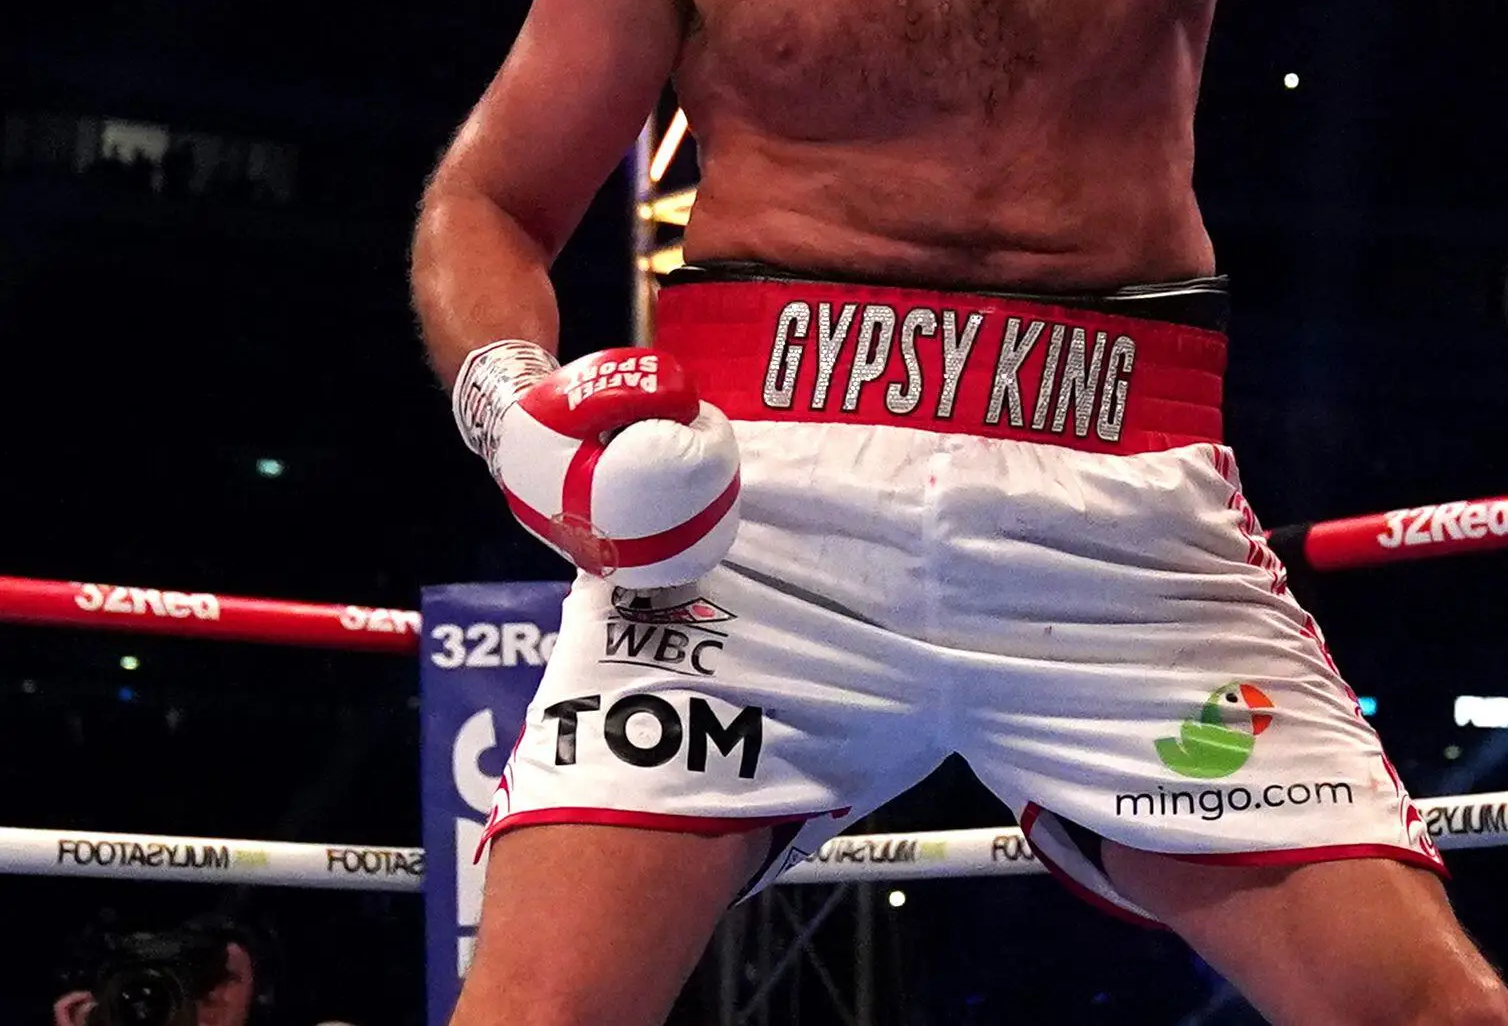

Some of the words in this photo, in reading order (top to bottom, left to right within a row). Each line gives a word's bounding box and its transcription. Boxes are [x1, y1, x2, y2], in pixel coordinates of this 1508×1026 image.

[562, 355, 659, 394] SPORT
[567, 371, 658, 411] PAFFEN
[763, 300, 984, 418] GYPSY
[984, 317, 1137, 442] KING
[431, 622, 559, 668] 32R
[606, 623, 724, 675] WBC
[543, 694, 763, 779] TOM
[1116, 782, 1353, 821] mingo.com
[57, 839, 230, 870] FOOTASYLUM
